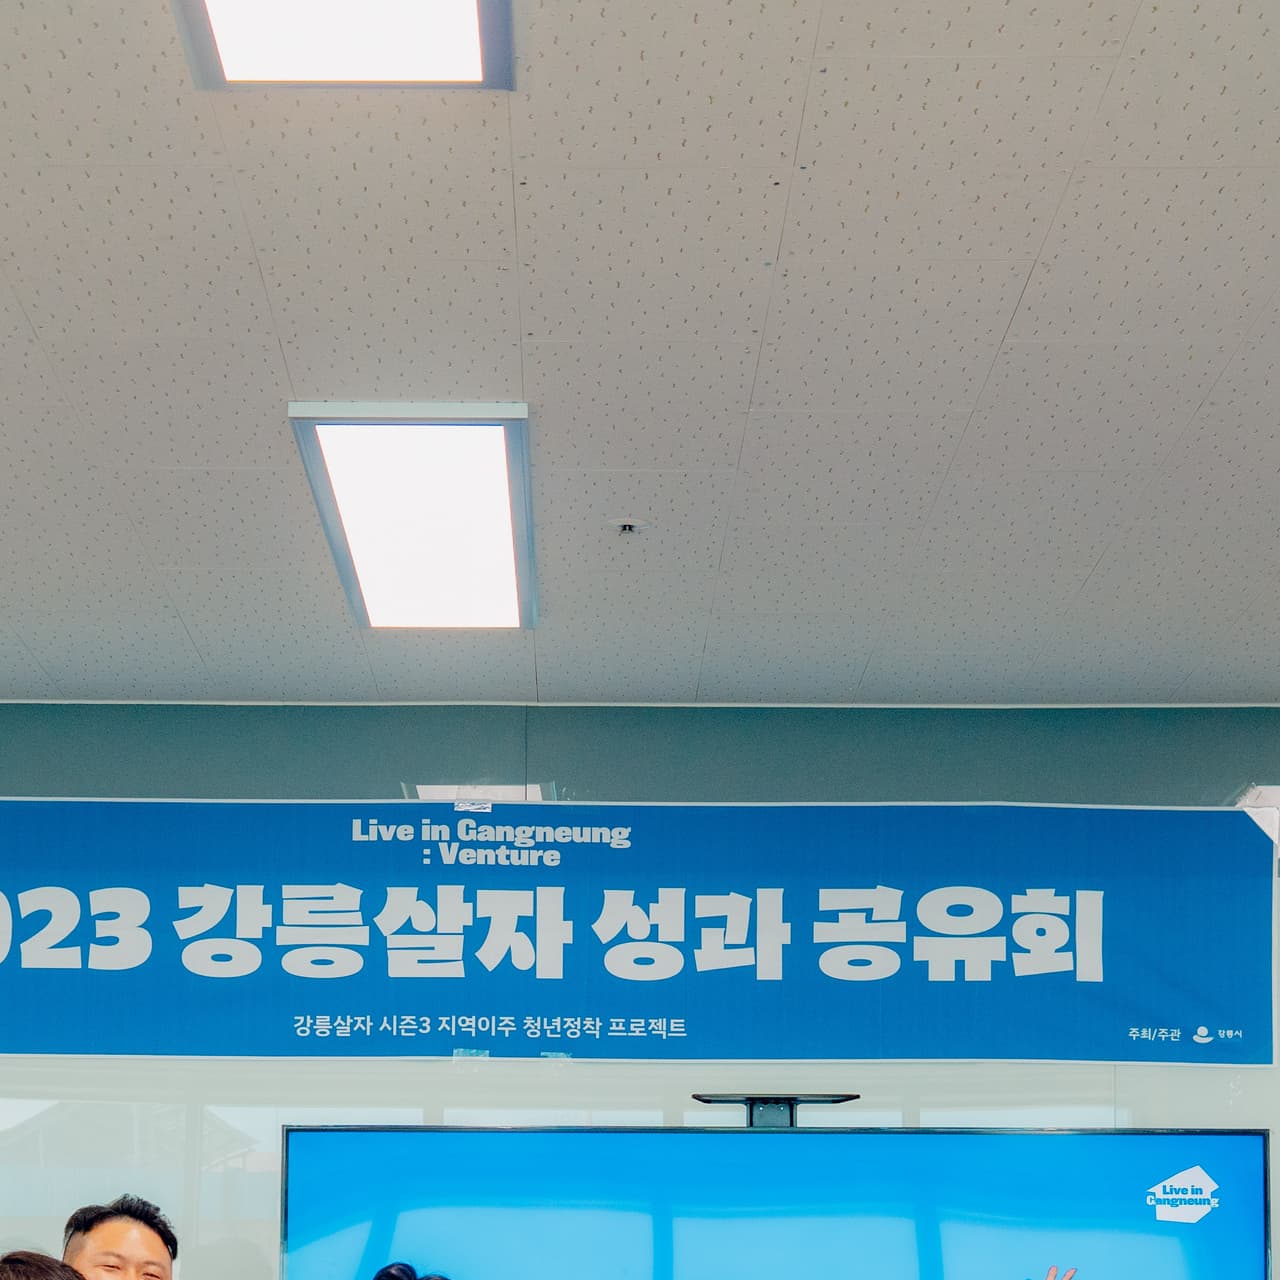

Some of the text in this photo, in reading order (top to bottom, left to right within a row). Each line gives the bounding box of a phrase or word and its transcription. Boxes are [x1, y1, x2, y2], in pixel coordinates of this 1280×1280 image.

[351, 818, 632, 849] Live in Gangneung
[438, 842, 561, 867] Venture
[172, 881, 574, 980] 강릉살자
[591, 885, 792, 982] 성과
[812, 884, 1105, 983] 공유회
[292, 1014, 688, 1040] 강릉살자 시즌3 지역이주 청년정착 프로젝트
[1128, 1027, 1243, 1041] 주최/주관 강릉시
[1146, 1195, 1220, 1208] Gangneung
[1162, 1184, 1203, 1195] Live in
